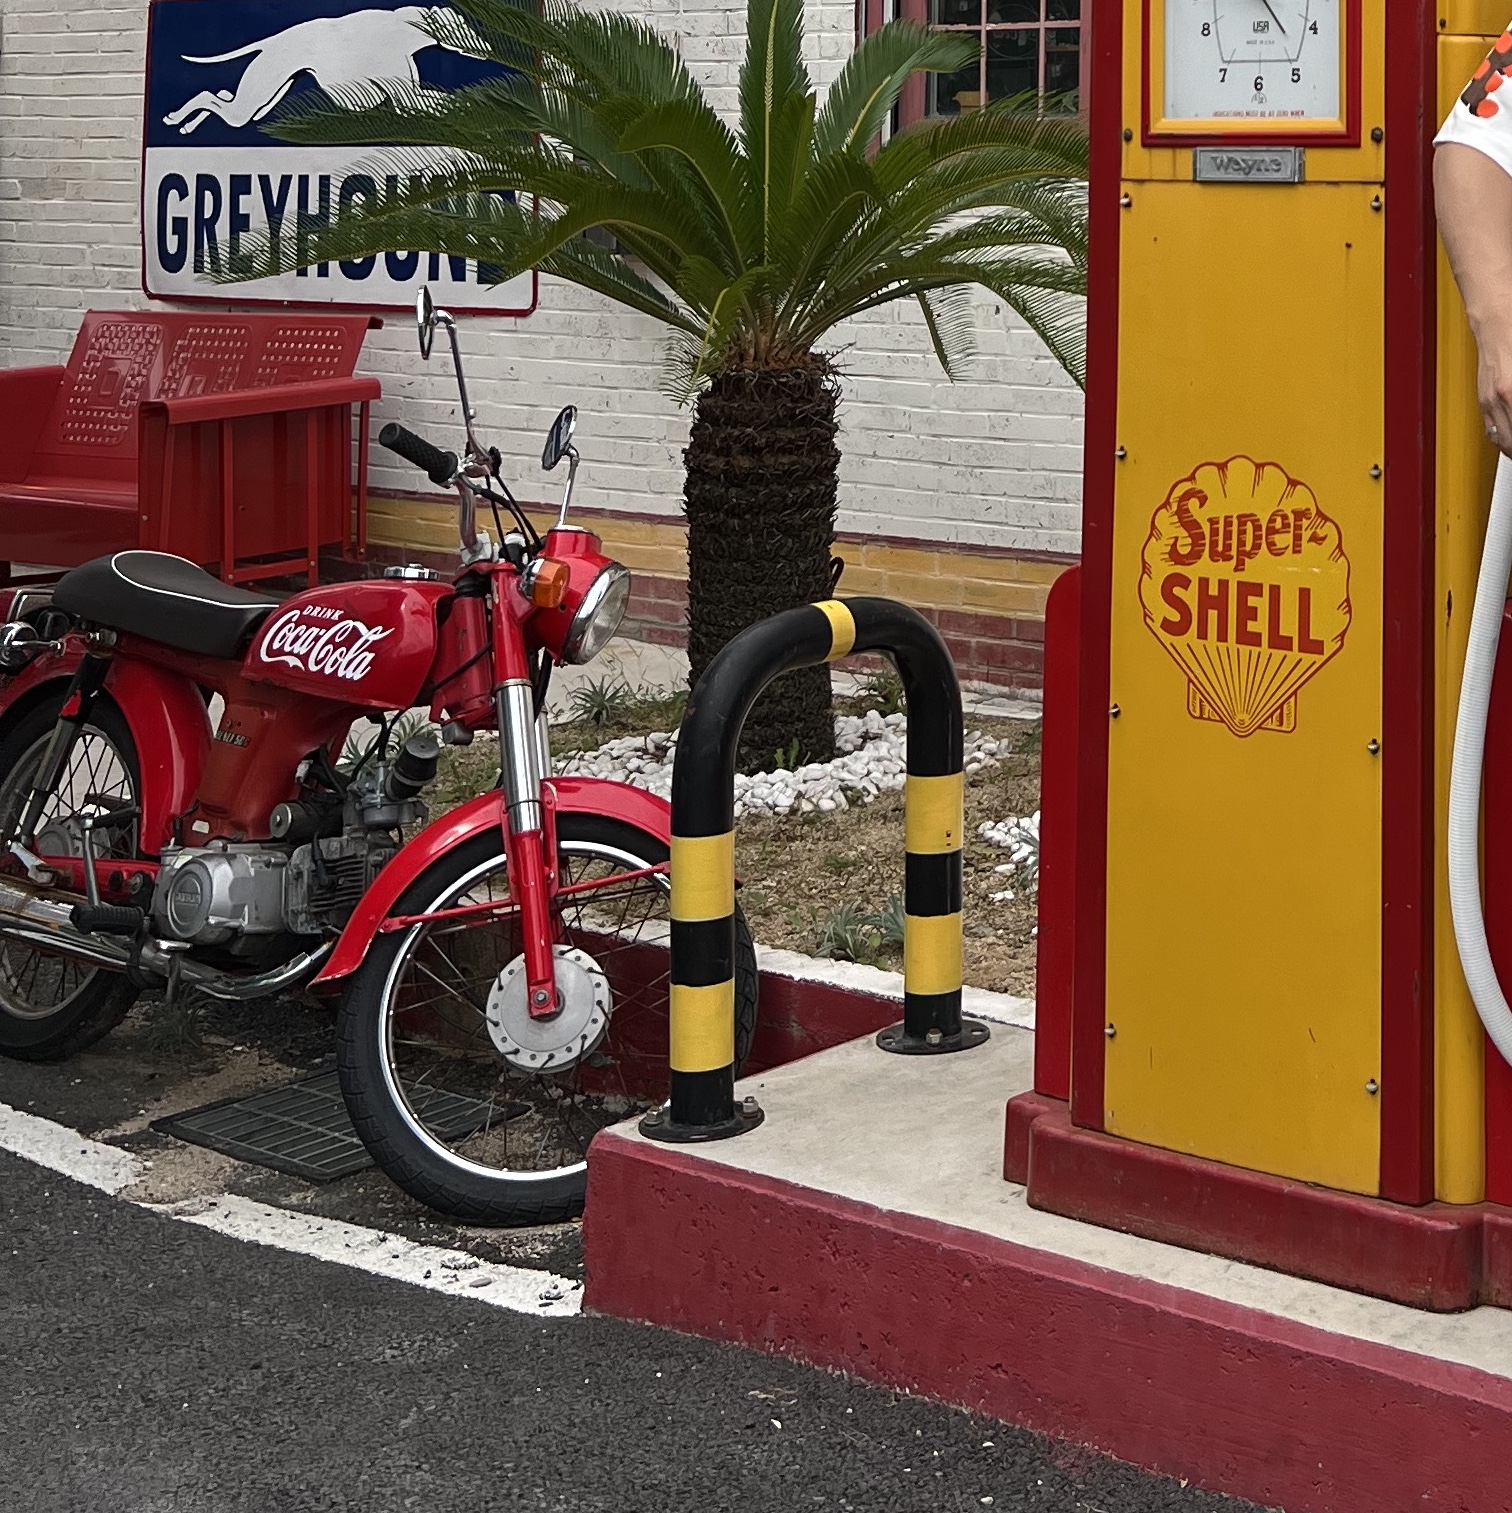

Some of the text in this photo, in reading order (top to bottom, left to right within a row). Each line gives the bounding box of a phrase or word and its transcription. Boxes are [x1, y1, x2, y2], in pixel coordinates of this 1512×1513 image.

[1201, 22, 1211, 37] 8
[1309, 20, 1318, 35] 4
[1219, 68, 1228, 83] 7
[1254, 75, 1264, 92] 6
[1291, 68, 1301, 83] 5
[1210, 155, 1282, 175] Wayne
[303, 605, 344, 621] DRINK
[1160, 572, 1325, 656] SHELL
[260, 609, 394, 681] Coca-Cola
